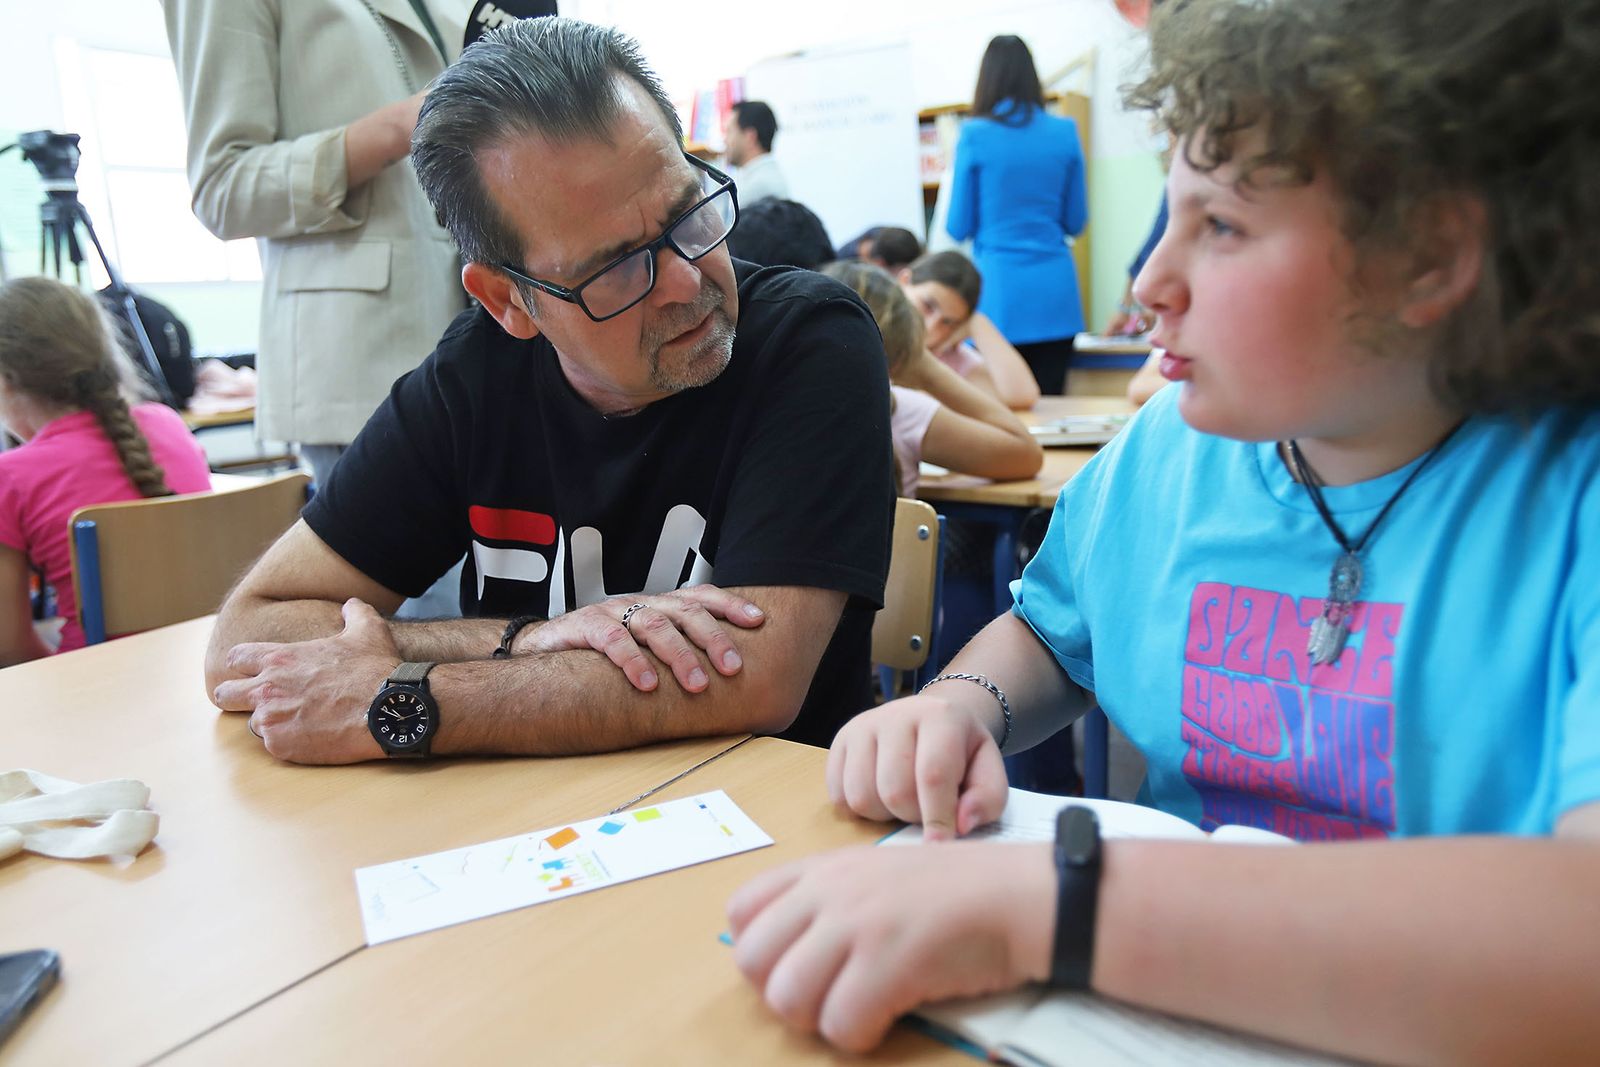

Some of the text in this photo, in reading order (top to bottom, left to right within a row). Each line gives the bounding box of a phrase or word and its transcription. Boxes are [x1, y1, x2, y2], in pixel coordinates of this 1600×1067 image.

[398, 694, 406, 702] 6
[415, 704, 424, 712] 8
[381, 725, 390, 734] 2
[416, 723, 425, 733] 10
[398, 734, 408, 743] 12
